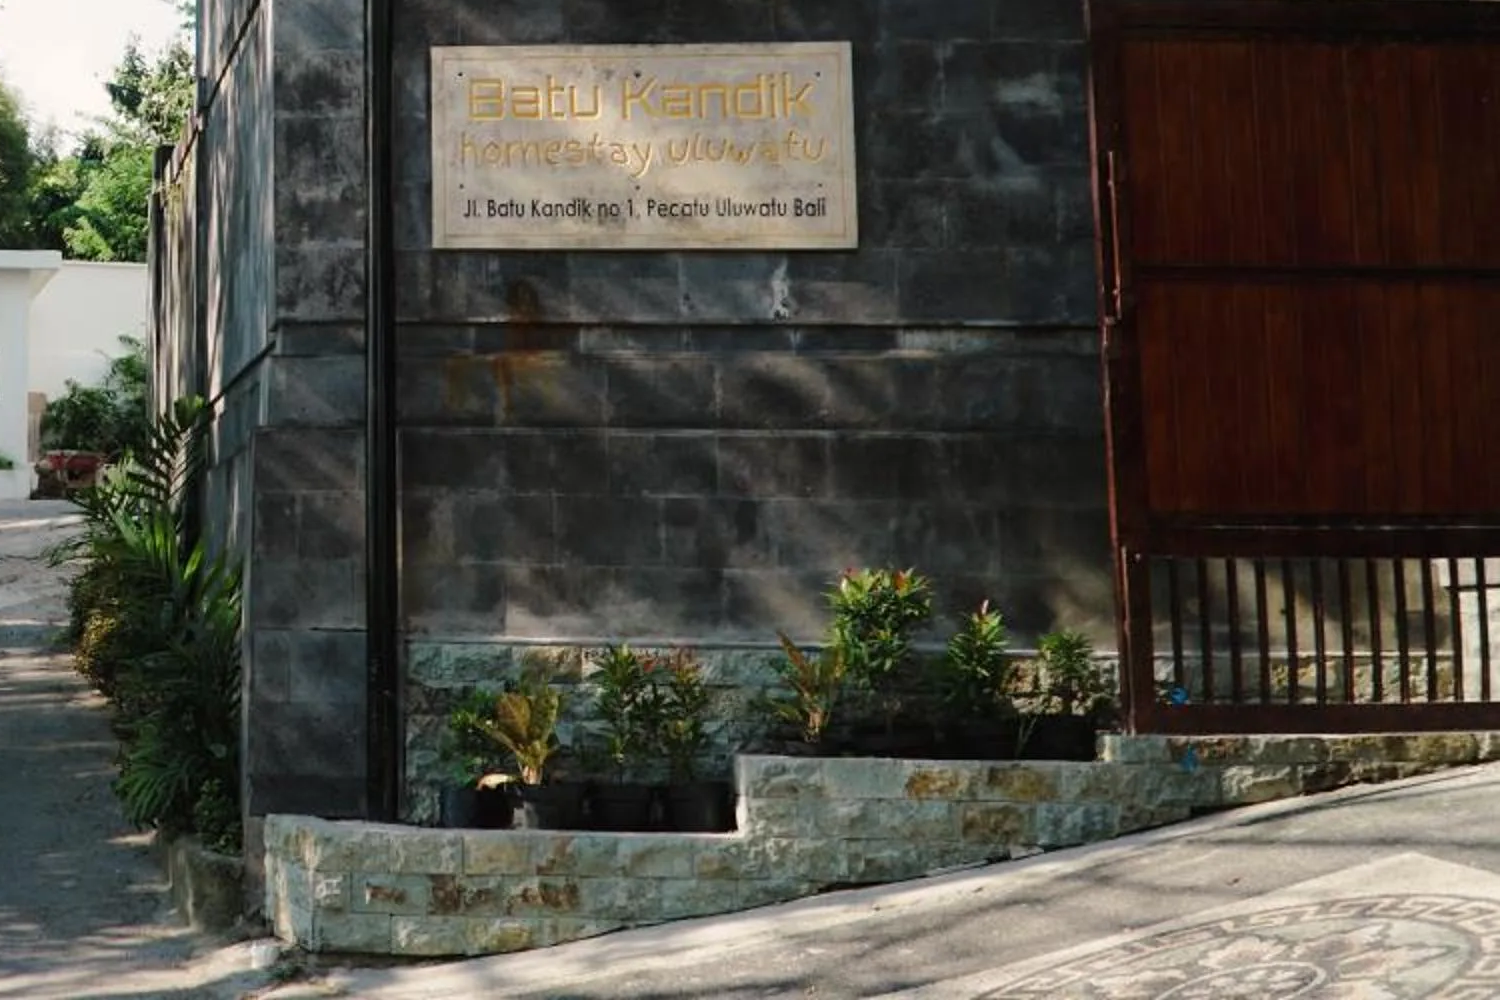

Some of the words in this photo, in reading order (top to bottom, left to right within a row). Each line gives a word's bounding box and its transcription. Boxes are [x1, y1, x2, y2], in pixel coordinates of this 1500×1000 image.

[468, 75, 601, 121] Batu
[622, 74, 814, 121] Kandik
[460, 131, 655, 178] homestay
[667, 131, 826, 165] uluwatu
[463, 200, 481, 218] Jl.
[487, 200, 526, 218] Batu
[531, 199, 592, 218] Kandik
[597, 203, 620, 218] no
[646, 199, 710, 218] Pecatu
[715, 198, 787, 217] Uluwatu
[793, 198, 827, 217] Bali
